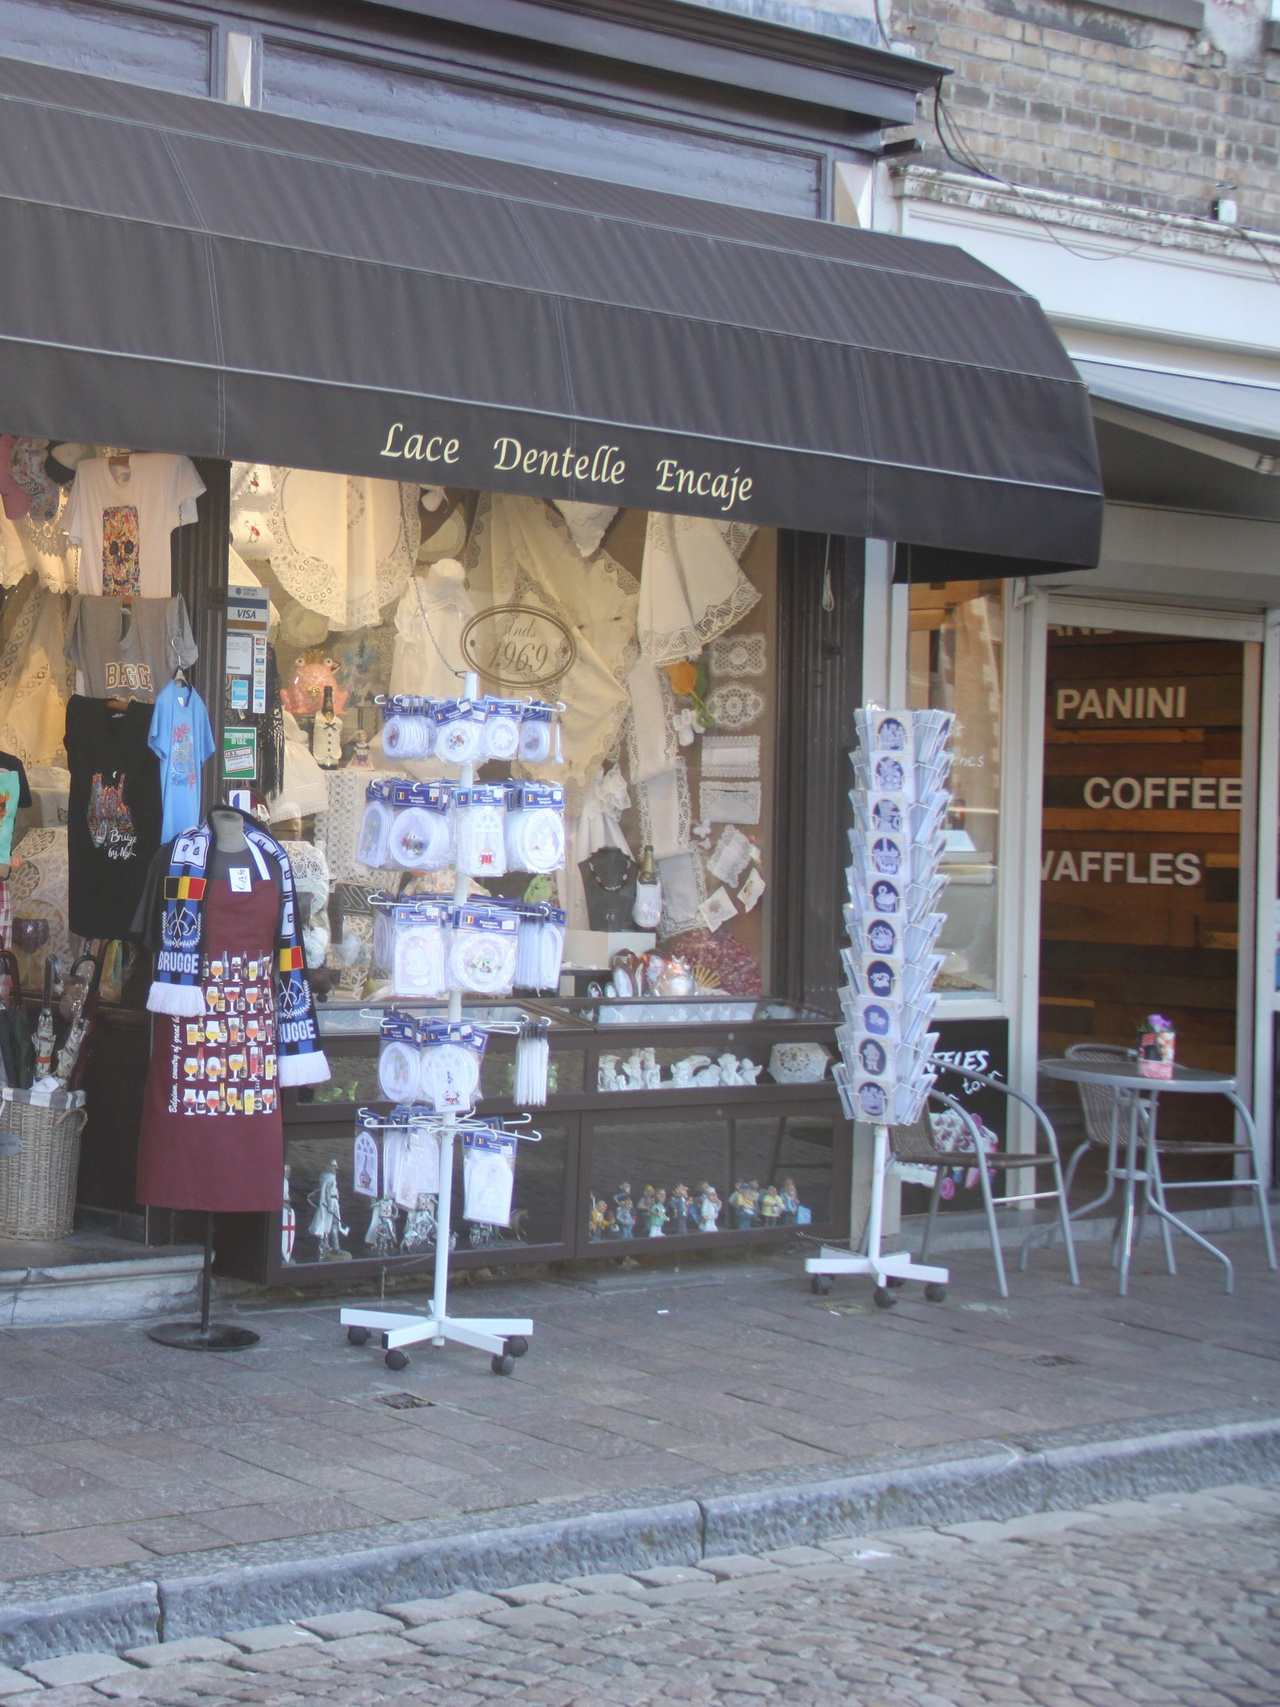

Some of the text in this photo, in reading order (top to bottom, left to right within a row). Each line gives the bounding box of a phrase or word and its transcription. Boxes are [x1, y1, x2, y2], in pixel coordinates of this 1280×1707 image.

[380, 423, 753, 511] Lace Dentelle Encaje
[237, 609, 256, 619] VISA
[487, 641, 548, 673] 1969
[1056, 686, 1187, 720] PANINI
[1083, 776, 1243, 810] COFFEE
[158, 950, 199, 974] BRUGGE
[171, 1044, 182, 1053] of
